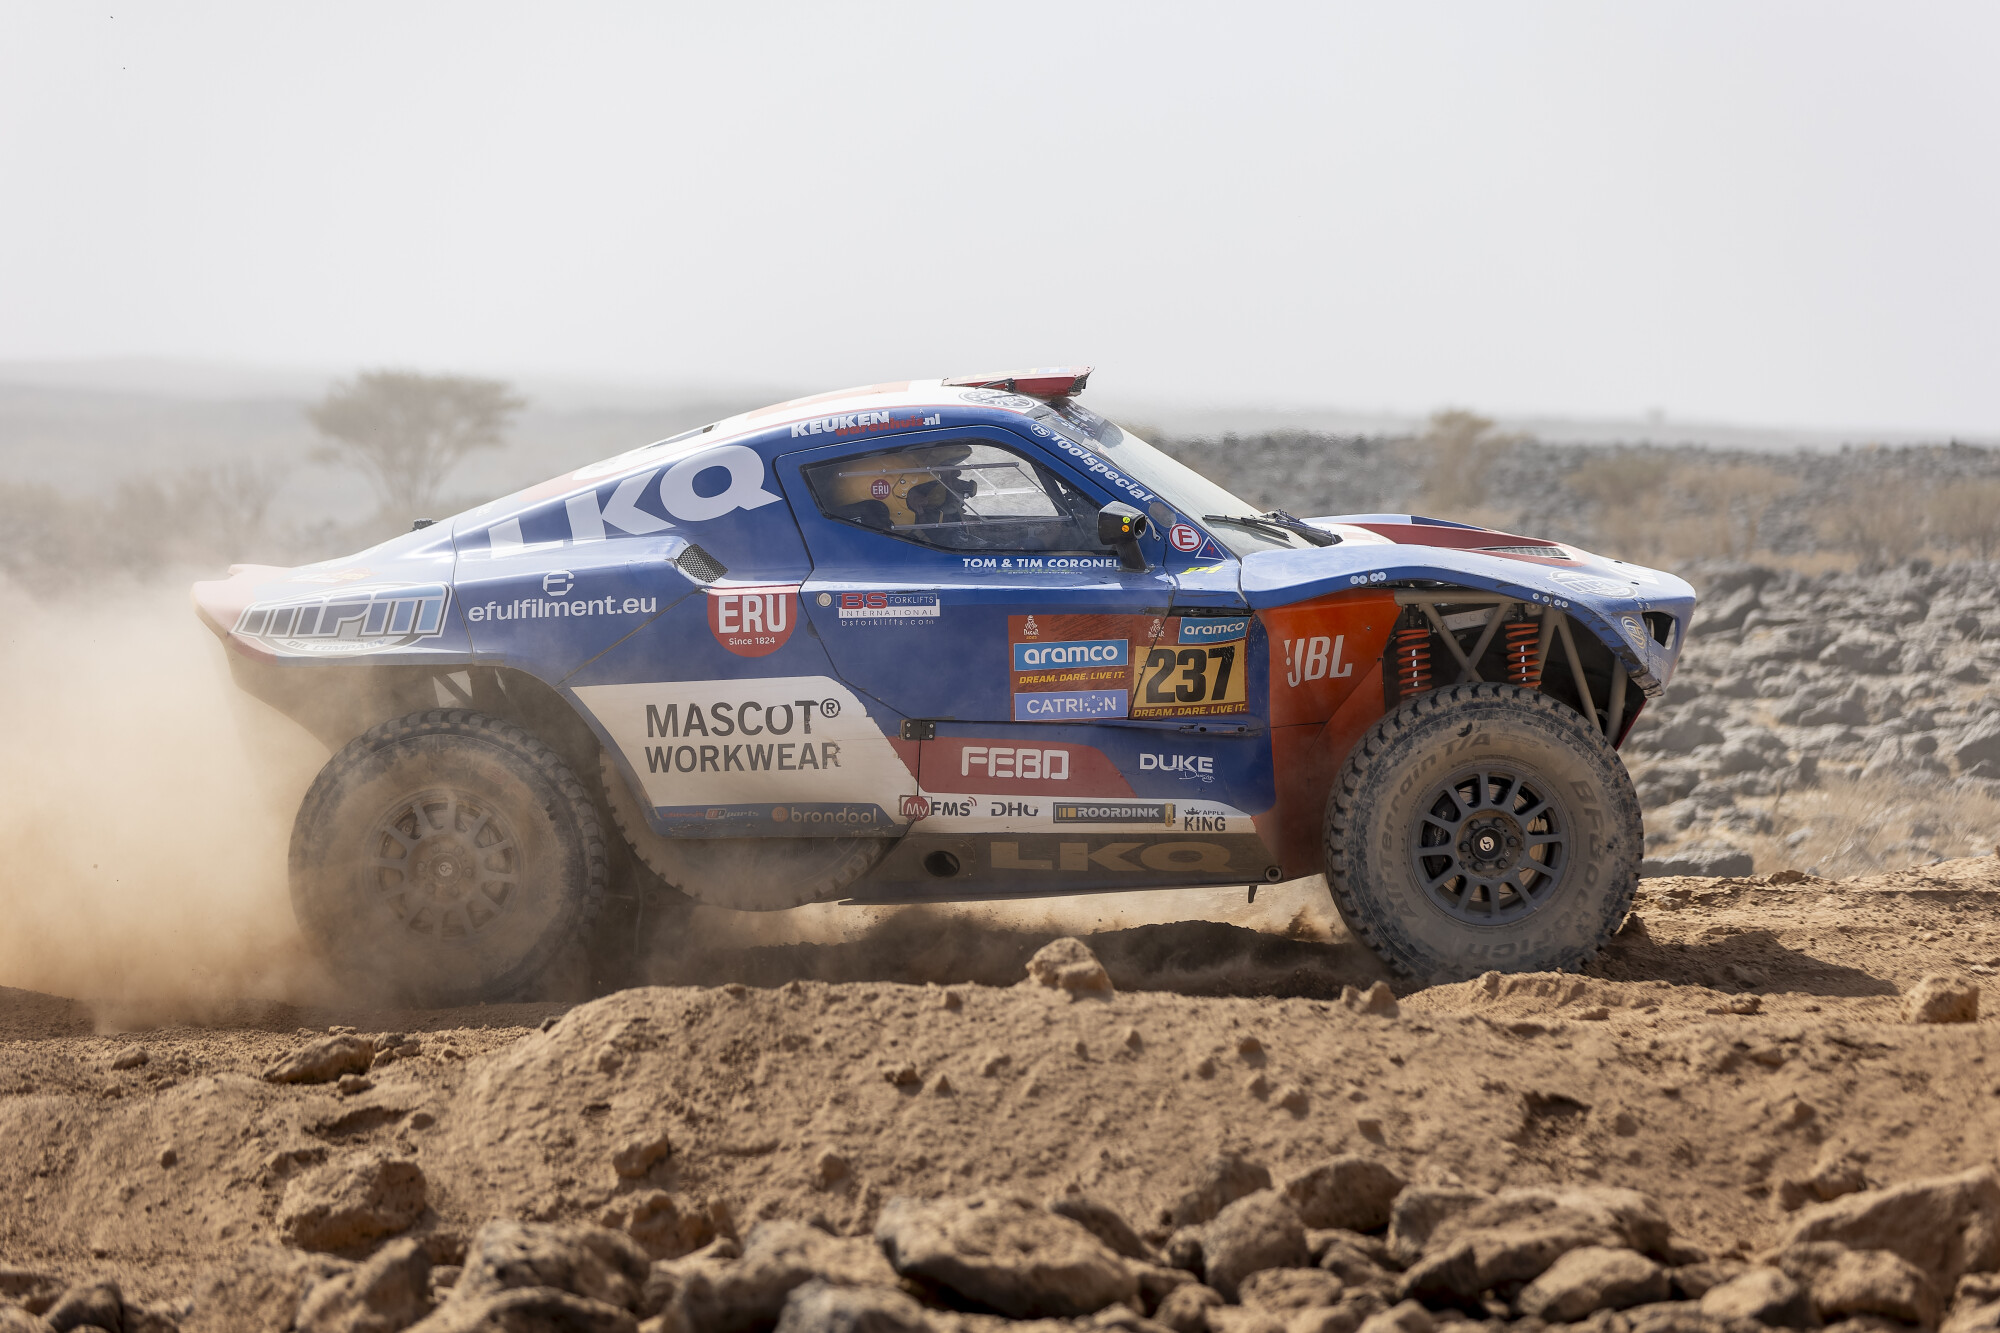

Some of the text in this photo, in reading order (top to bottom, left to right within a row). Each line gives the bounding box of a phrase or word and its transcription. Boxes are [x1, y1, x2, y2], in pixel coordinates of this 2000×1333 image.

[790, 411, 889, 438] KEUKEN
[1051, 433, 1154, 502] Toolspecial
[872, 485, 889, 495] ERU
[488, 445, 782, 558] LKQ
[1177, 528, 1194, 546] E
[963, 558, 1120, 568] TOM & TIM CORONEL
[468, 596, 657, 621] efulfilment.eu
[841, 593, 934, 609] BS FORKLIFTS
[717, 594, 786, 634] ERU
[1184, 622, 1244, 635] aramco
[287, 638, 386, 652] OIL COMPANY
[729, 637, 775, 646] Since 1824
[1024, 645, 1118, 664] aramco
[1286, 635, 1353, 687] JBL
[1019, 671, 1125, 684] DREAM. DARE. LIVE IT.
[1146, 646, 1235, 703] 237
[1134, 704, 1246, 717] DREAM. DARE. LIVE IT.
[645, 742, 841, 773] WORKWEAR
[961, 746, 1069, 780] FEBO
[1140, 753, 1213, 773] DUKE
[791, 807, 877, 824] brondool
[1078, 807, 1159, 818] ROORDINK
[1184, 816, 1226, 831] KING
[991, 841, 1236, 872] LKQ
